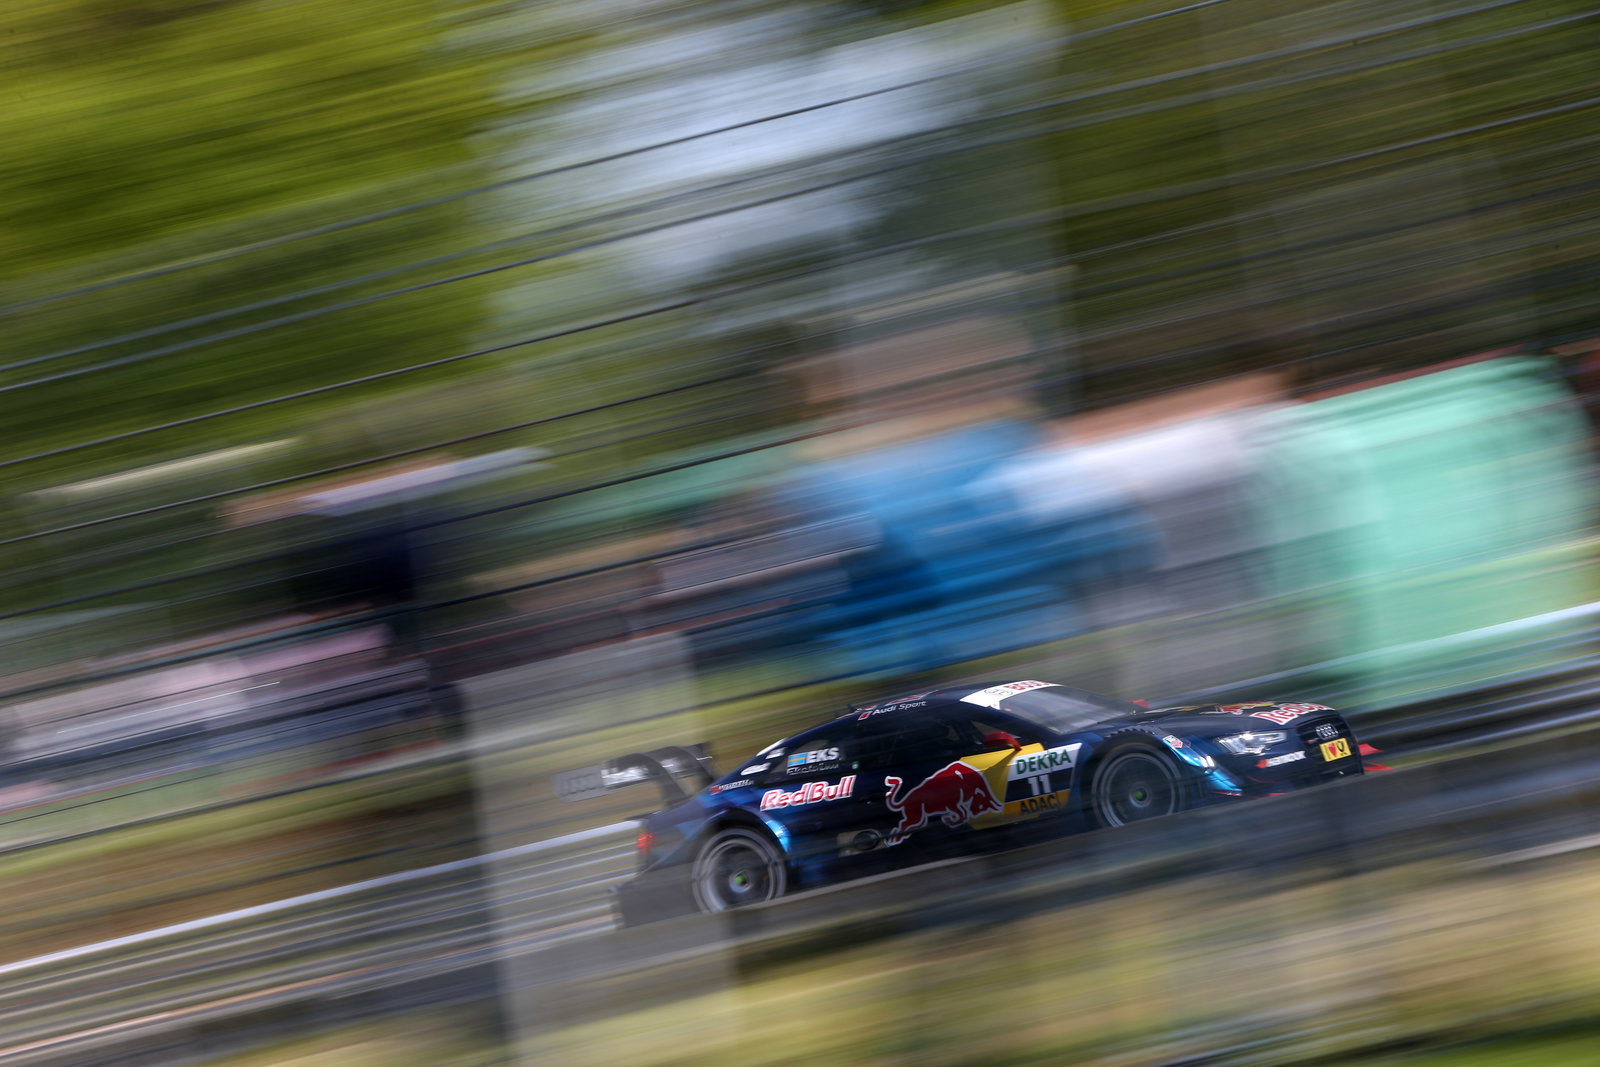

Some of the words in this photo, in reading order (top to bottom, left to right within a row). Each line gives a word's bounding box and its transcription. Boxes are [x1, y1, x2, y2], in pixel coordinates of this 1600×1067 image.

[872, 705, 897, 716] Audi
[898, 700, 927, 711] Sport
[806, 747, 840, 763] EKS
[1016, 749, 1073, 775] DEKRA
[1027, 774, 1052, 796] 11
